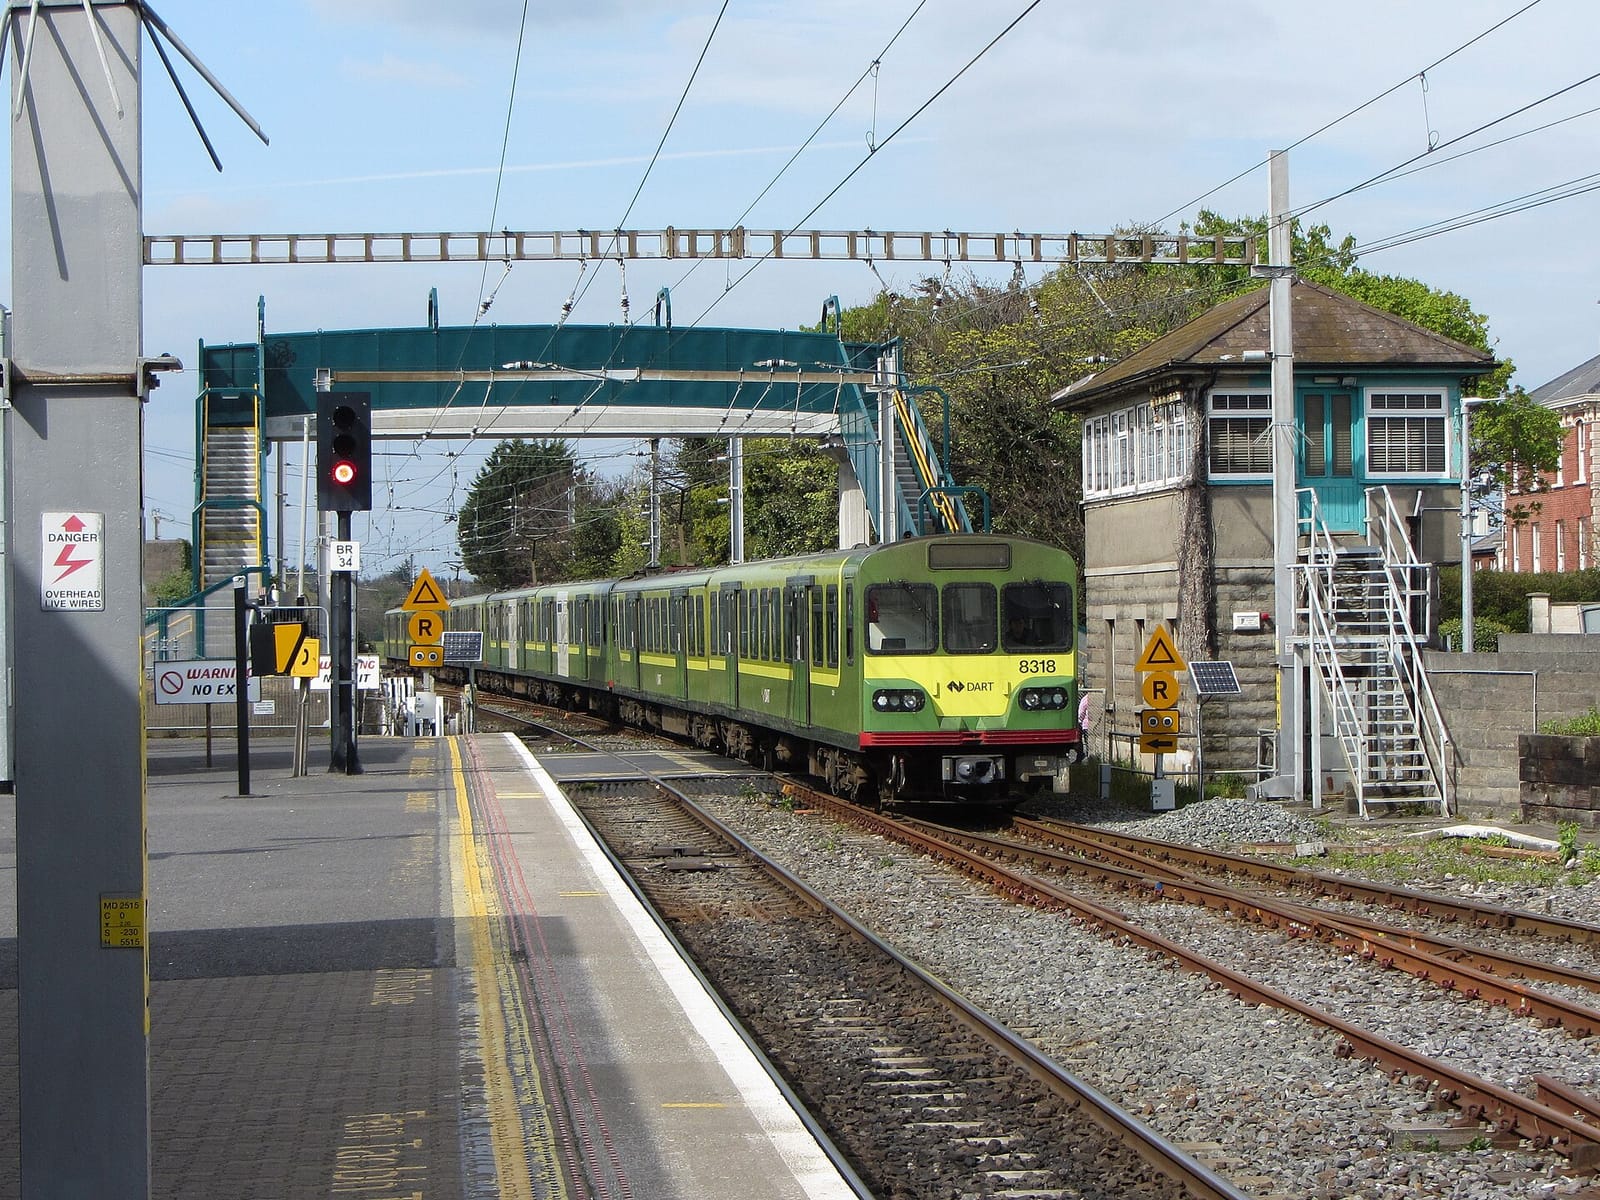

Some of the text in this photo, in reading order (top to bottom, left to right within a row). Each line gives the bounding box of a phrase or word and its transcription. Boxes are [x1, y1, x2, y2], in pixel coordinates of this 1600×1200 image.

[48, 533, 98, 542] DANGER
[336, 545, 352, 554] BR
[339, 557, 352, 567] 34
[45, 590, 101, 599] OVERHEAD
[45, 600, 101, 608] LIVE WIRES
[418, 619, 432, 636] R
[1019, 660, 1056, 673] 8318
[187, 667, 251, 680] WARNI
[191, 685, 212, 695] NO
[967, 682, 994, 692] DART
[1152, 680, 1169, 700] R
[103, 902, 140, 910] MD 2515
[104, 929, 110, 937] S
[120, 938, 141, 946] 5515
